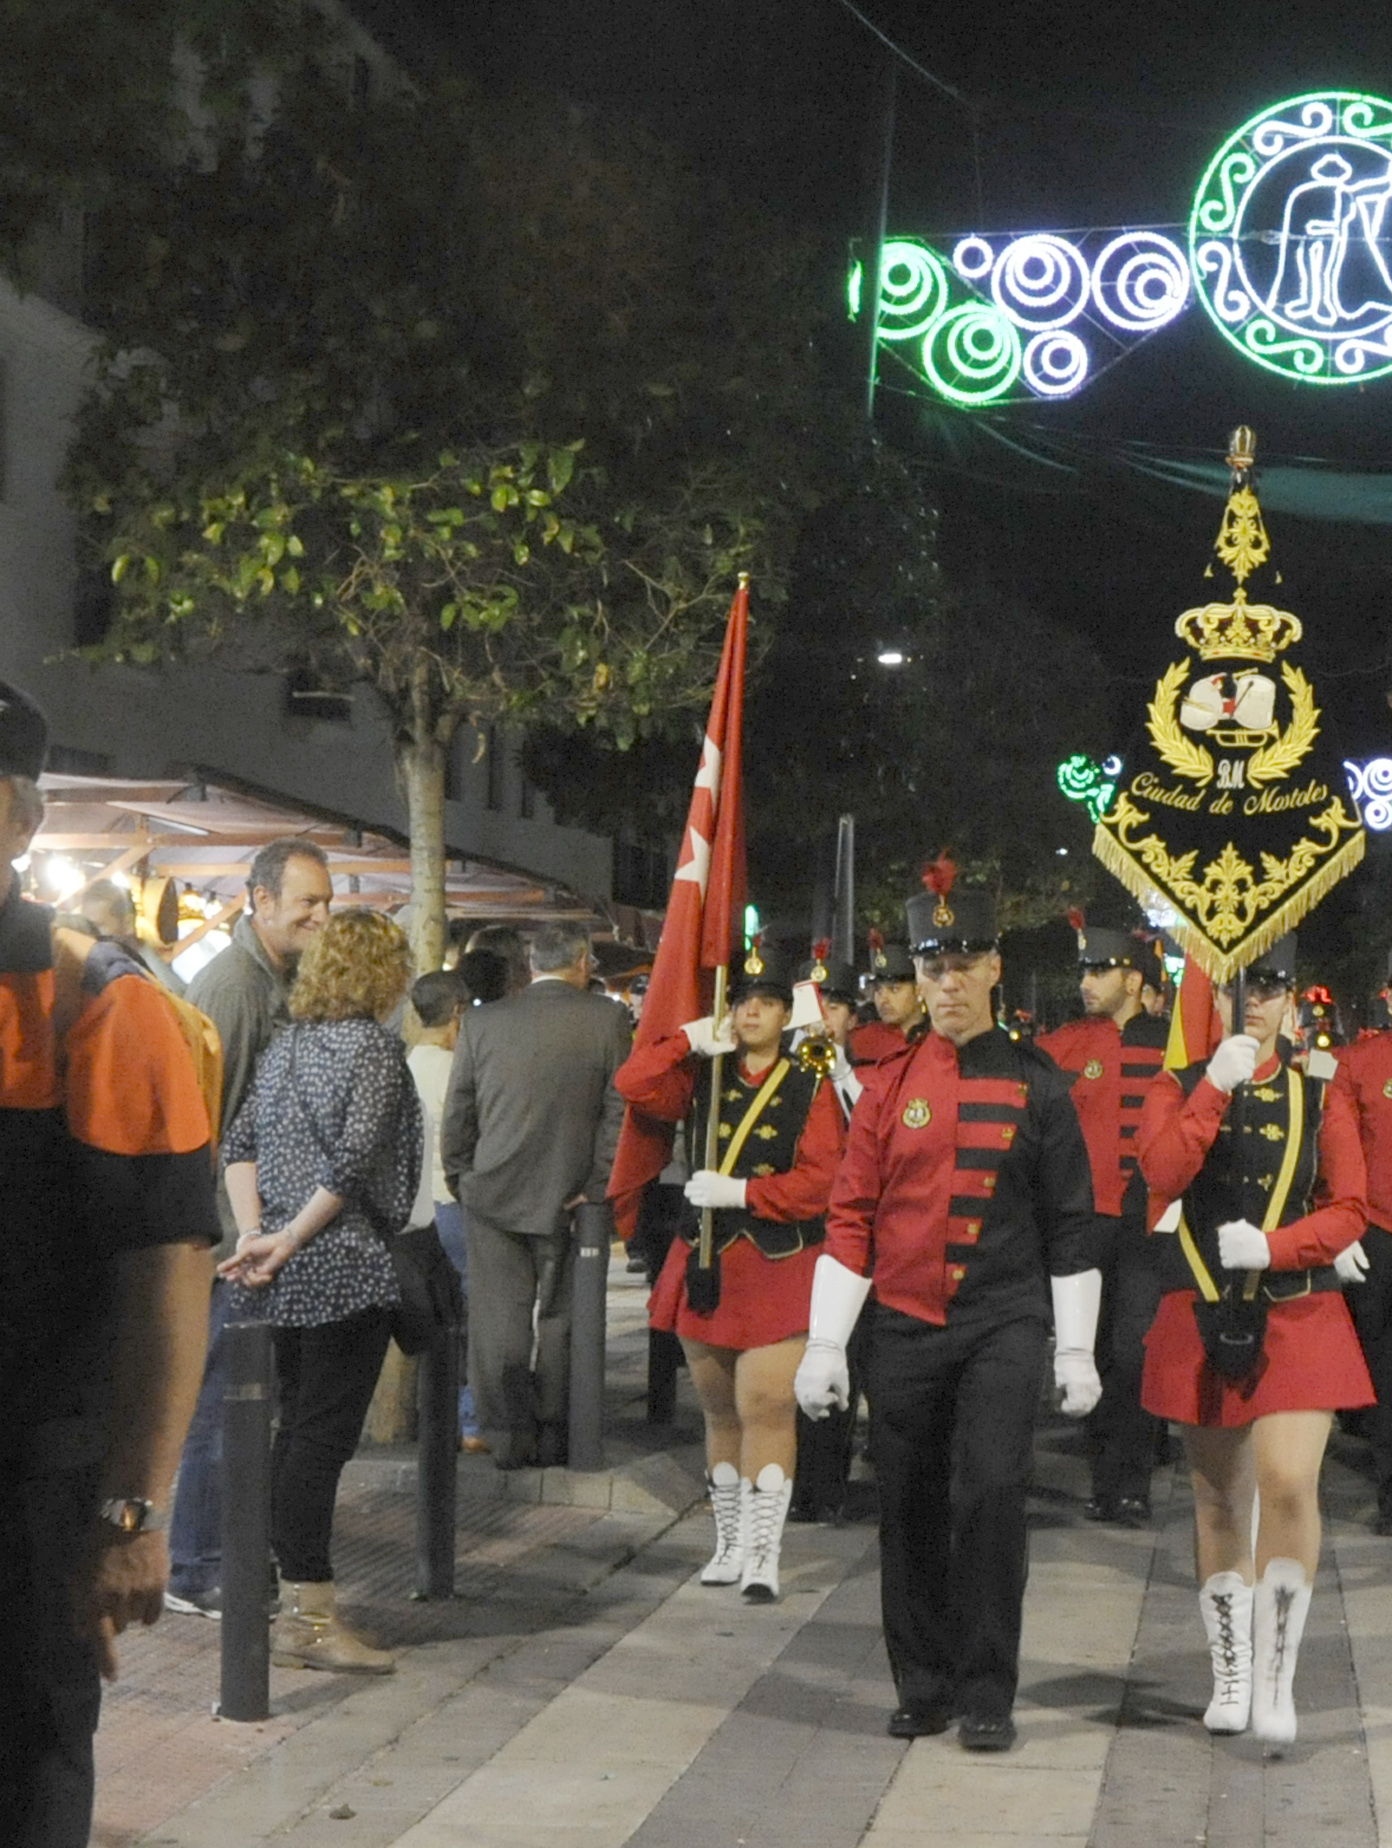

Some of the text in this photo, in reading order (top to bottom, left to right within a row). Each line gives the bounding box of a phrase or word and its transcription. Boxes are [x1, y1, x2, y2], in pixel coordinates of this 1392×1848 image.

[1131, 771, 1329, 815] Ciudad de Mostoles
